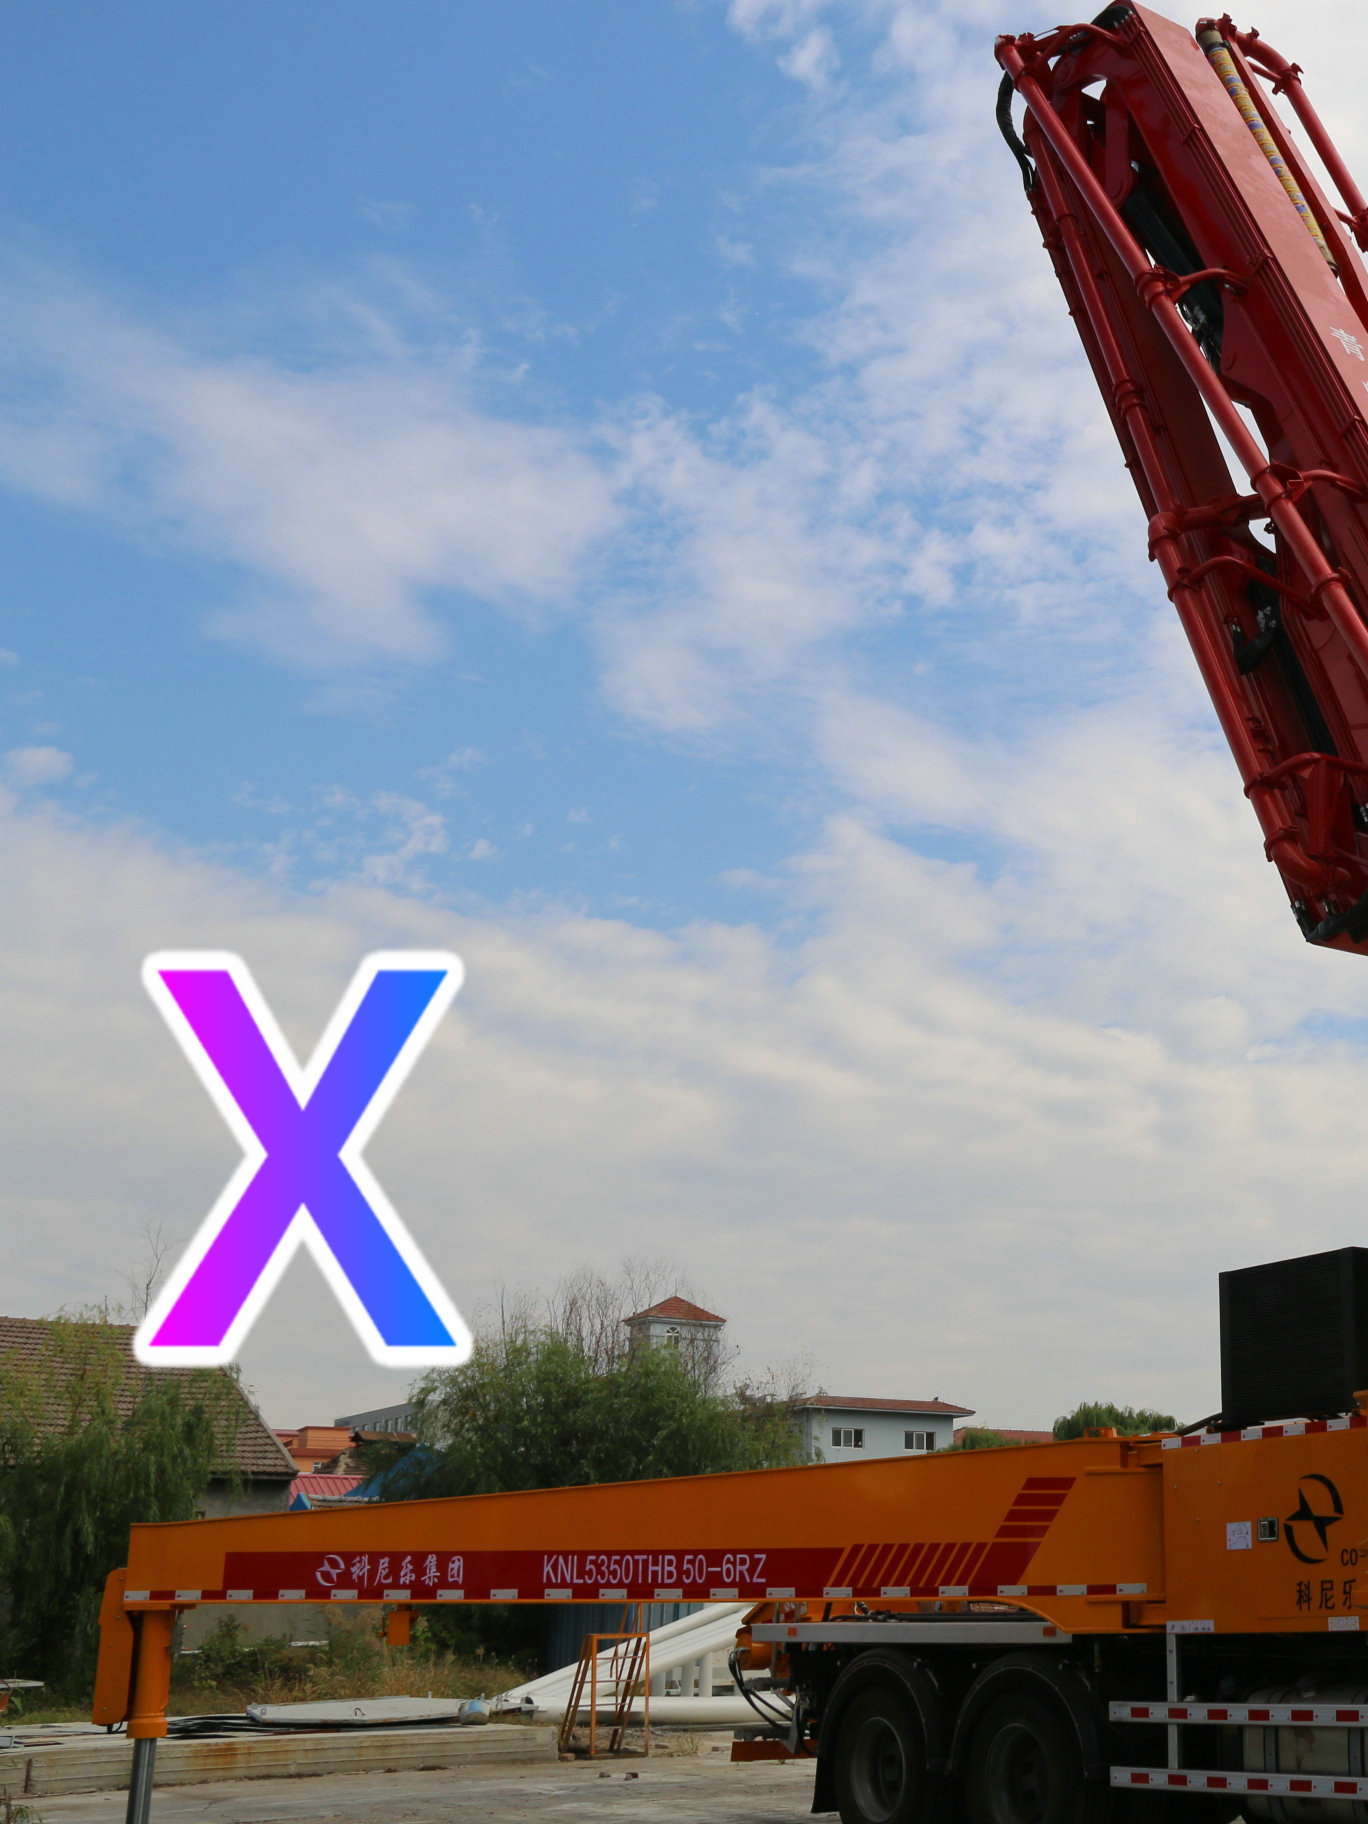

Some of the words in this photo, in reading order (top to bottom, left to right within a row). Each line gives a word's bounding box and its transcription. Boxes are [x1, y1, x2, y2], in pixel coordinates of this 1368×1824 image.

[350, 1553, 465, 1588] 科尼乐集团
[542, 1554, 677, 1584] KNL5350THB
[682, 1553, 767, 1583] 50-6RZ
